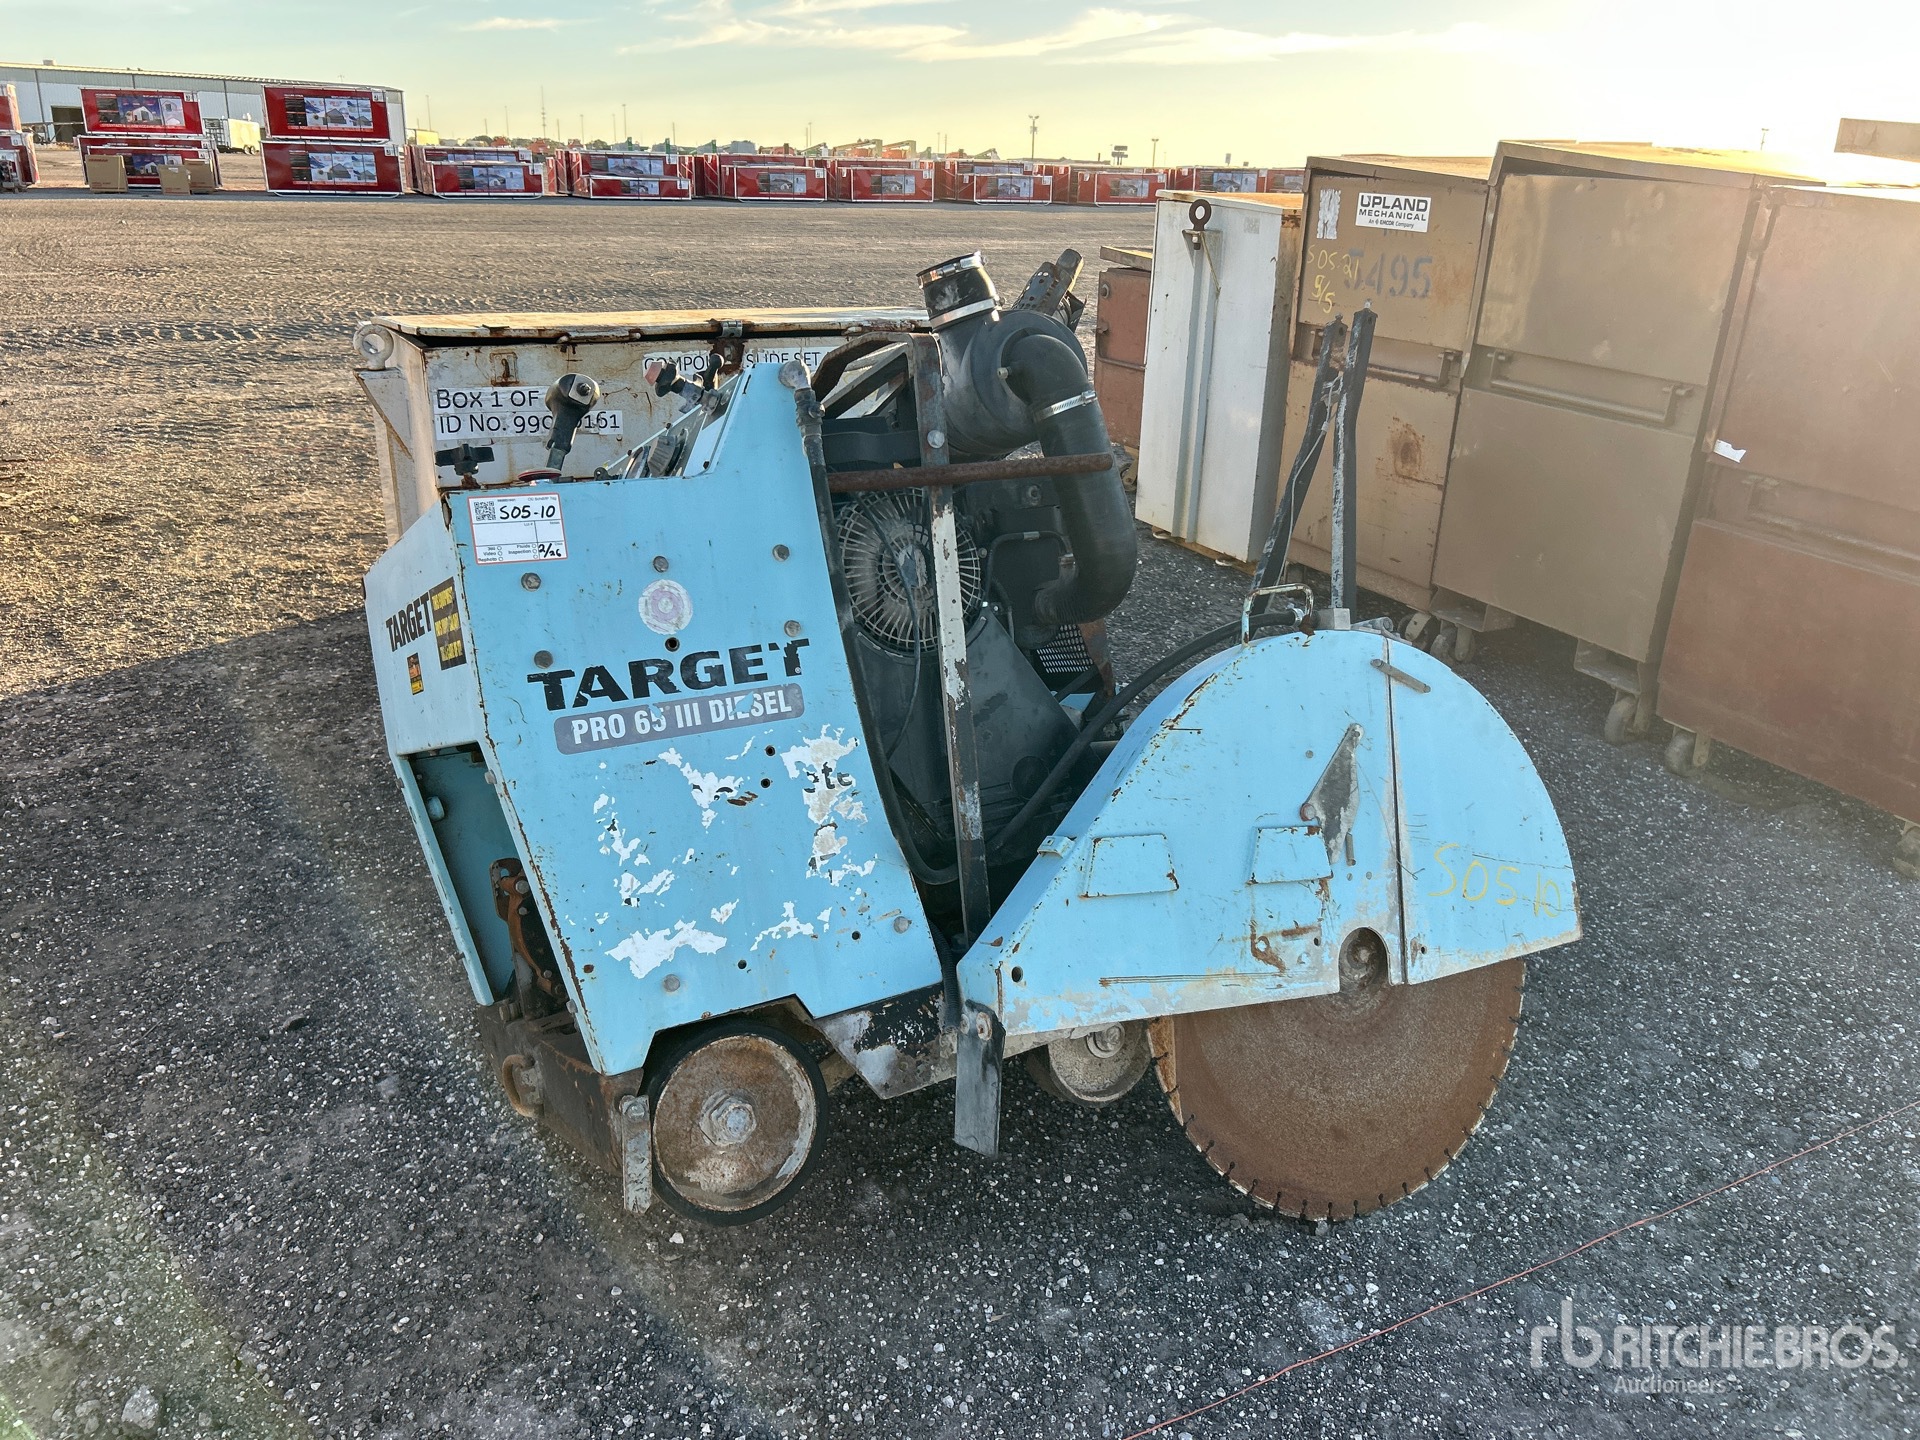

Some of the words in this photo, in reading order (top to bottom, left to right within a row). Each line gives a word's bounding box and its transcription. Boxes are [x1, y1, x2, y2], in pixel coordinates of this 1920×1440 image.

[1360, 194, 1428, 212] UPLAND
[1359, 208, 1426, 222] MECHANICAL
[1395, 220, 1415, 229] Company
[793, 351, 821, 367] SET
[490, 390, 503, 408] 1
[510, 390, 540, 407] OF
[439, 415, 462, 433] ID
[385, 591, 432, 652] TARGET
[527, 638, 810, 711] TARGET
[571, 713, 627, 745] PRO
[634, 708, 667, 735] 65
[674, 702, 701, 729] III
